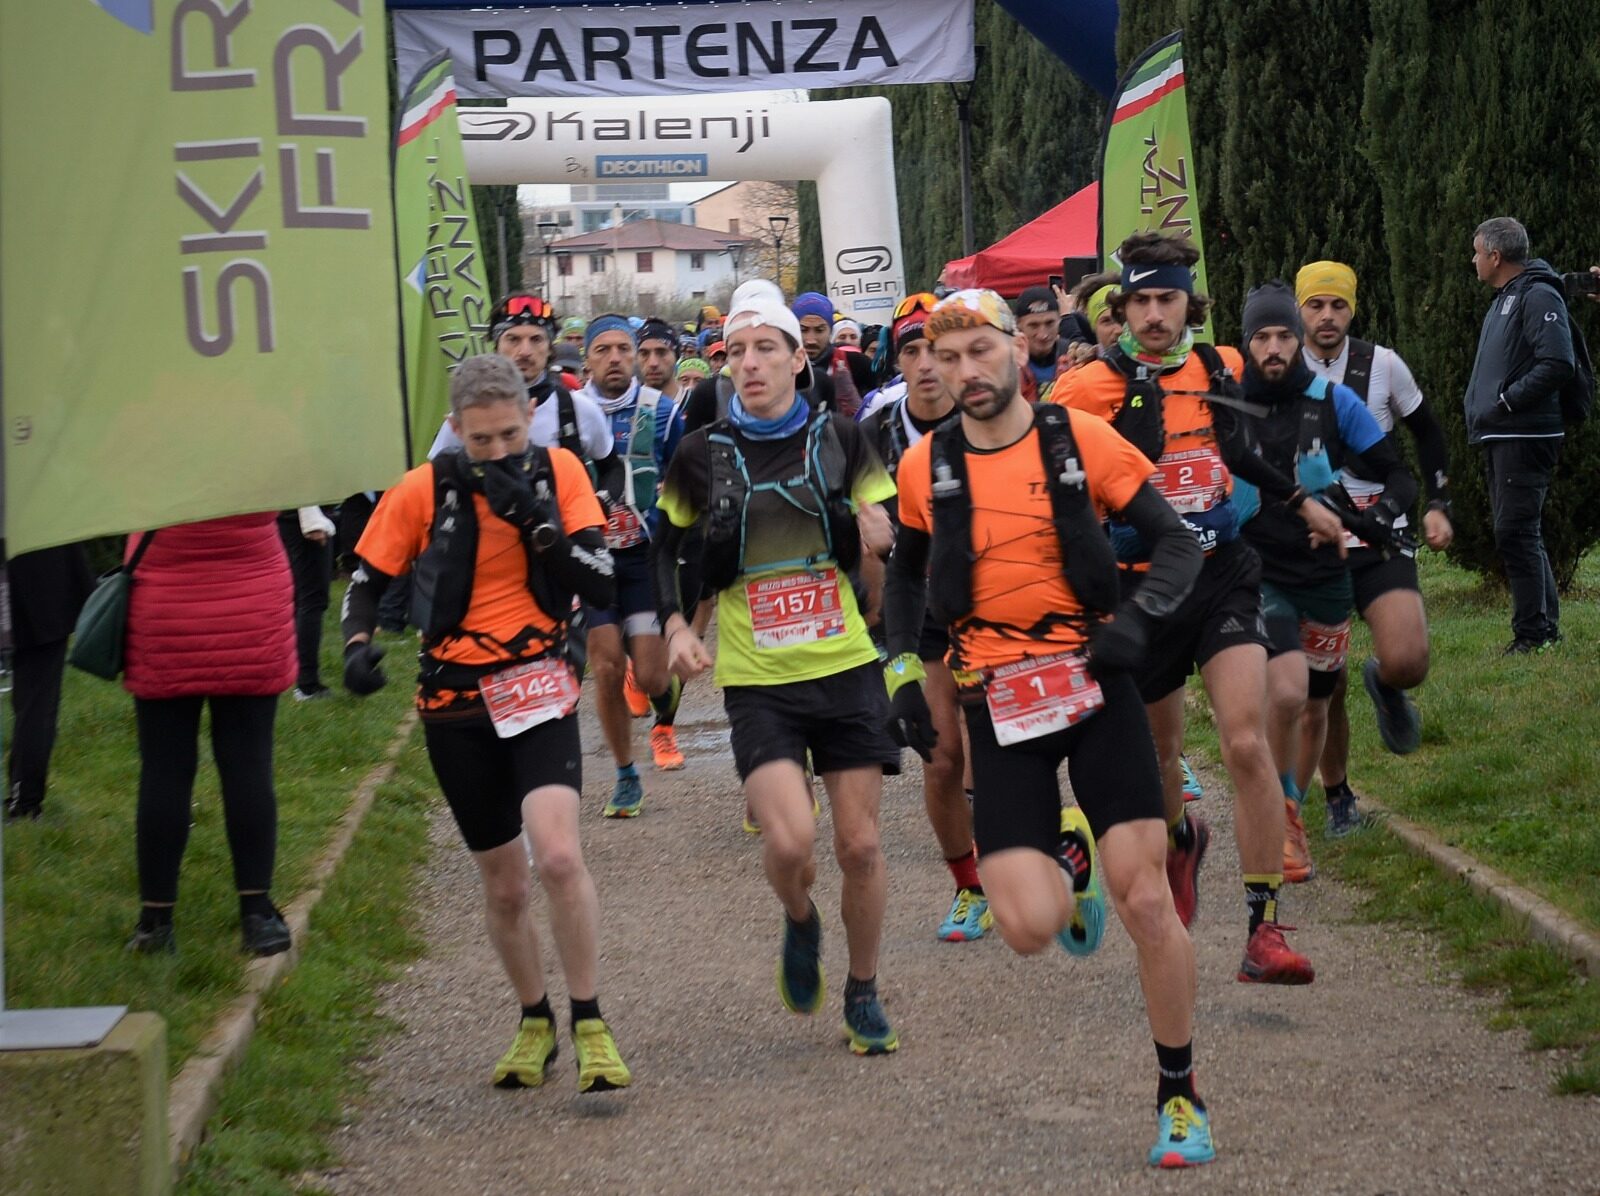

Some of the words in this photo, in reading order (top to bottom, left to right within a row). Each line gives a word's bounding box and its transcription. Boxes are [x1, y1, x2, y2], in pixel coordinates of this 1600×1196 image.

[473, 15, 899, 83] PARTENZA
[547, 109, 769, 152] Kalenji
[601, 159, 701, 175] DECATHLON
[175, 138, 275, 357] SKI
[1178, 466, 1194, 485] 2
[774, 589, 817, 615] 157
[511, 674, 560, 702] 142
[1029, 675, 1047, 697] 1
